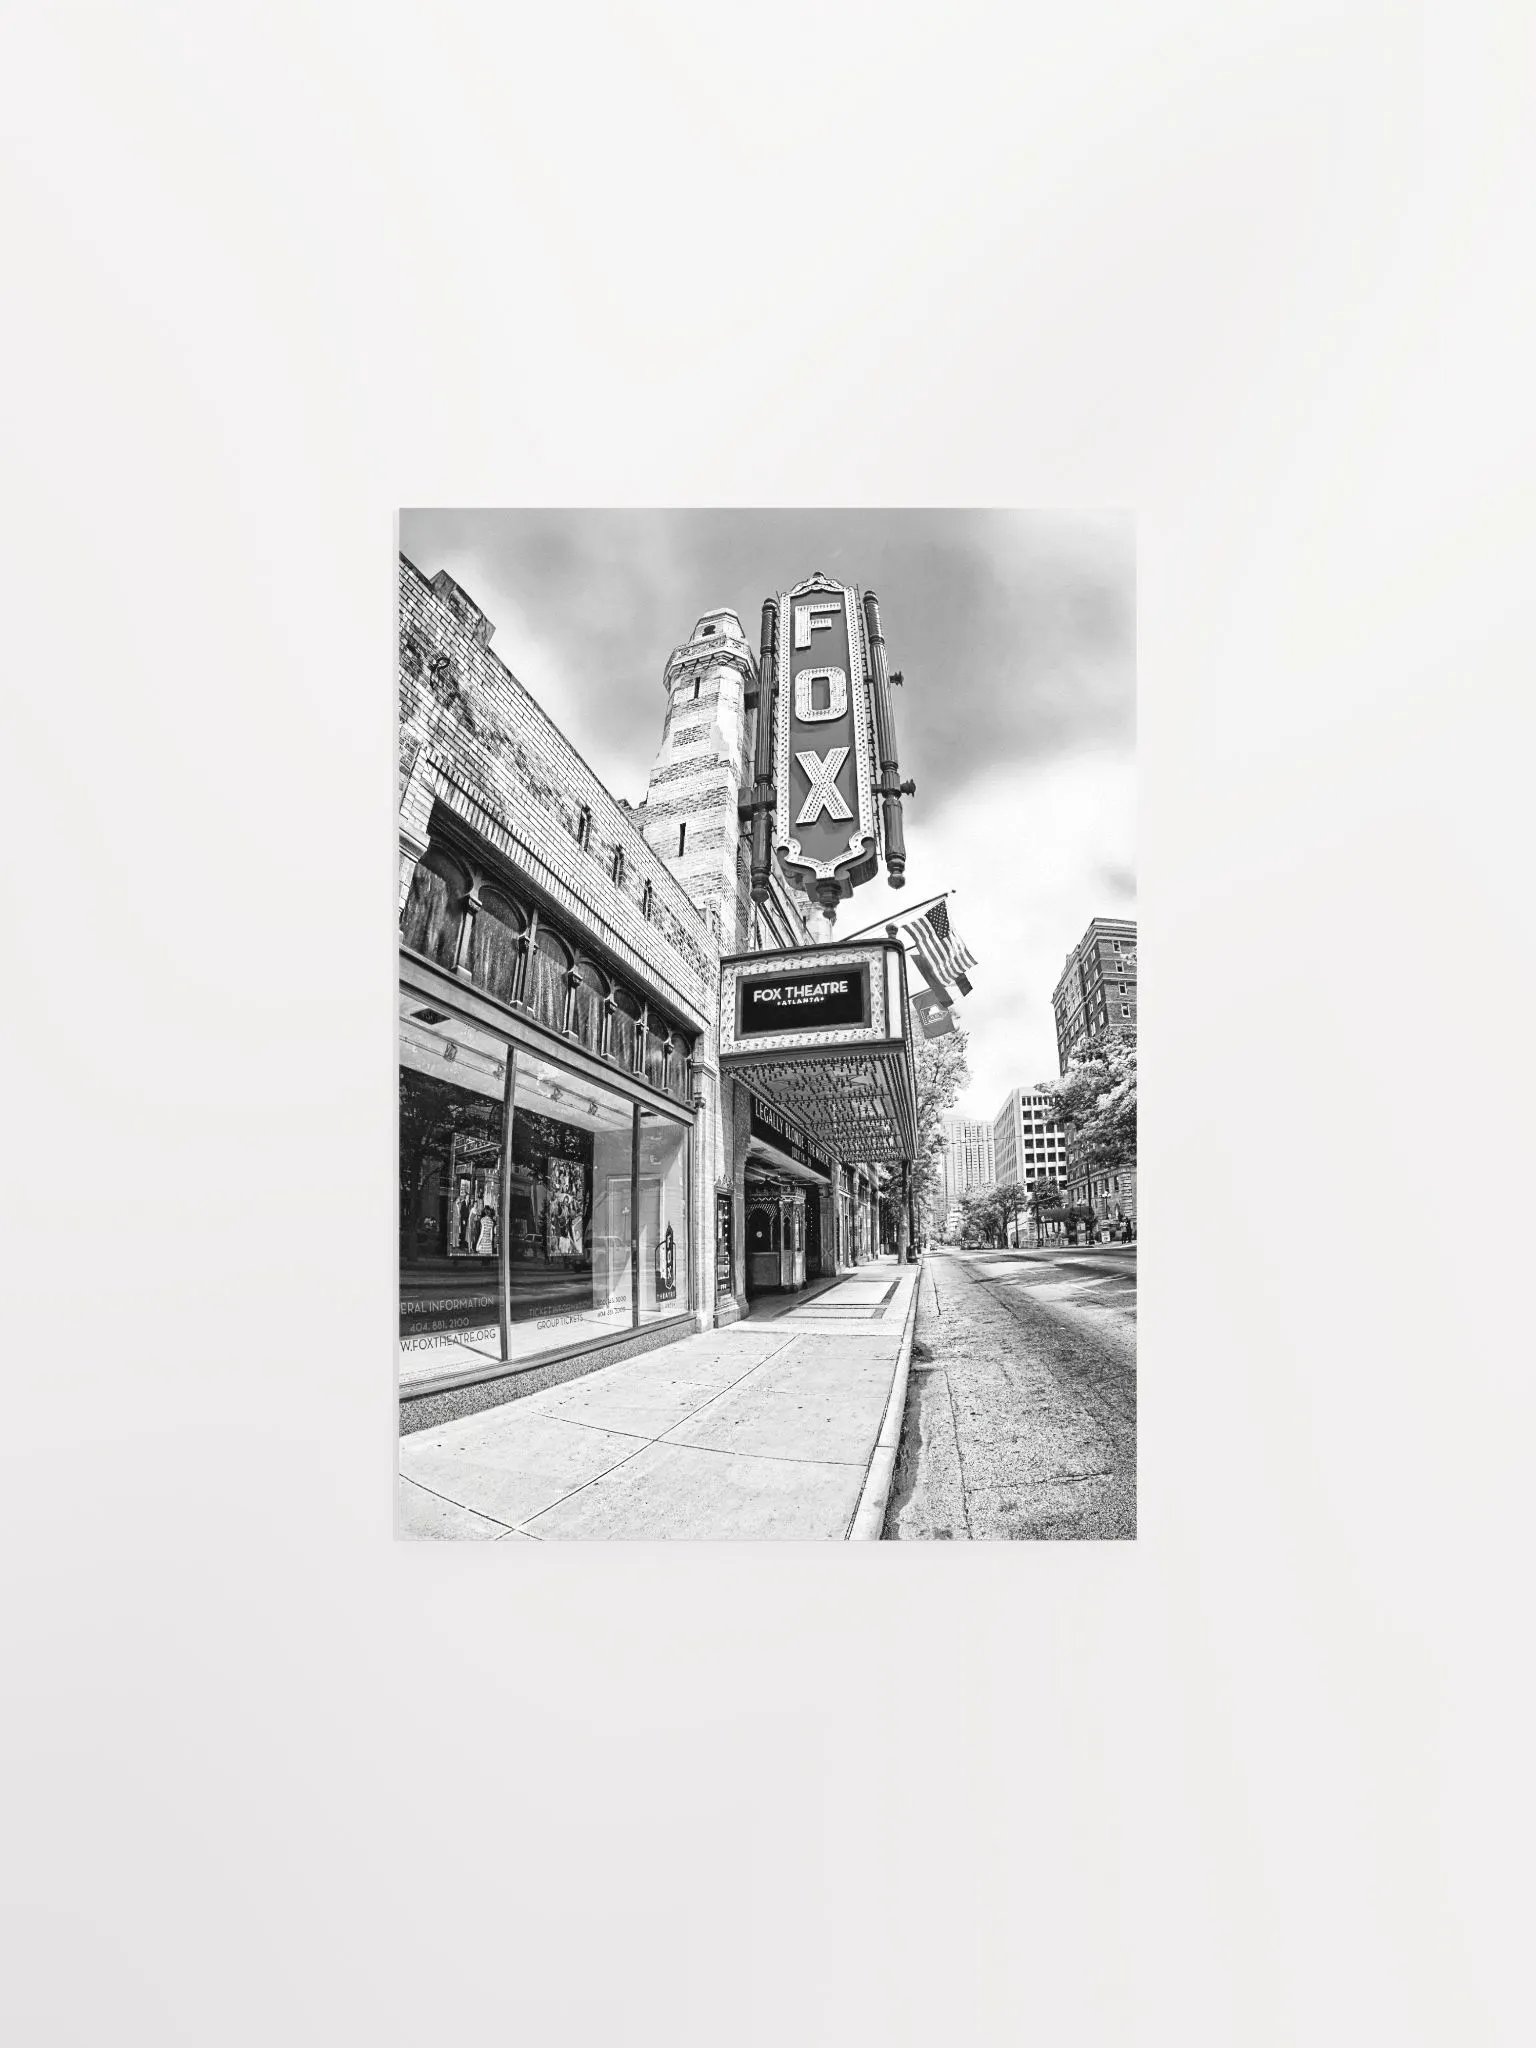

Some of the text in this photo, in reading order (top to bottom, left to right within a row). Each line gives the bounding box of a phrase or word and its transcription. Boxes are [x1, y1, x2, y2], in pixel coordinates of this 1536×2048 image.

[794, 602, 853, 827] FOX
[753, 980, 849, 1002] FOX THEATRE
[755, 1098, 784, 1134] LEGALLY
[400, 1296, 494, 1315] ERAL INFORMATION
[537, 1319, 559, 1330] GROUP
[560, 1314, 584, 1326] TICKETS
[400, 1328, 496, 1352] W.FOXTHEATRE.ORG
